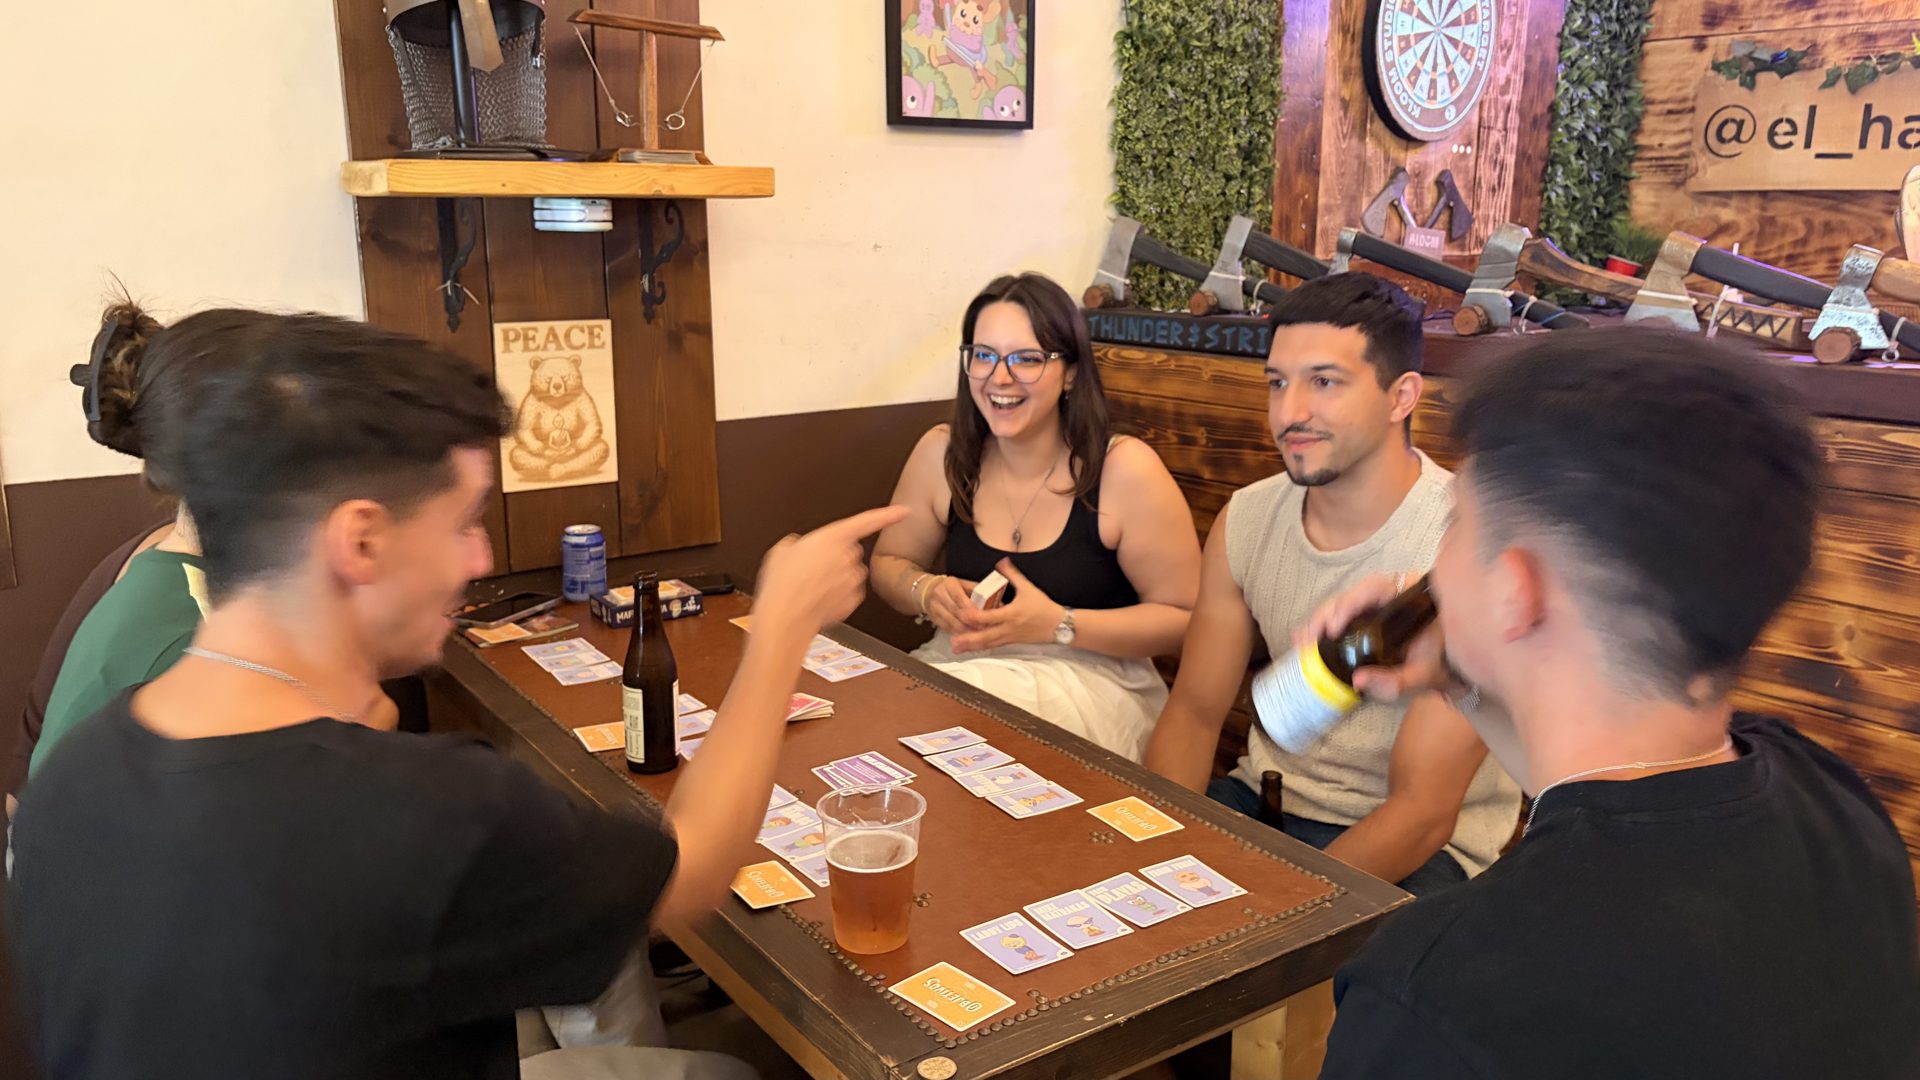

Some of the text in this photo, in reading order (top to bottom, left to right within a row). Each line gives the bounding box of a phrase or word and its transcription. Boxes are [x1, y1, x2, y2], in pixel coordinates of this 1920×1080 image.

[1383, 0, 1397, 62] STUDI
[500, 324, 606, 354] PEACE
[1088, 314, 1184, 347] THUNDER
[921, 977, 984, 1013] OBJETIVOS
